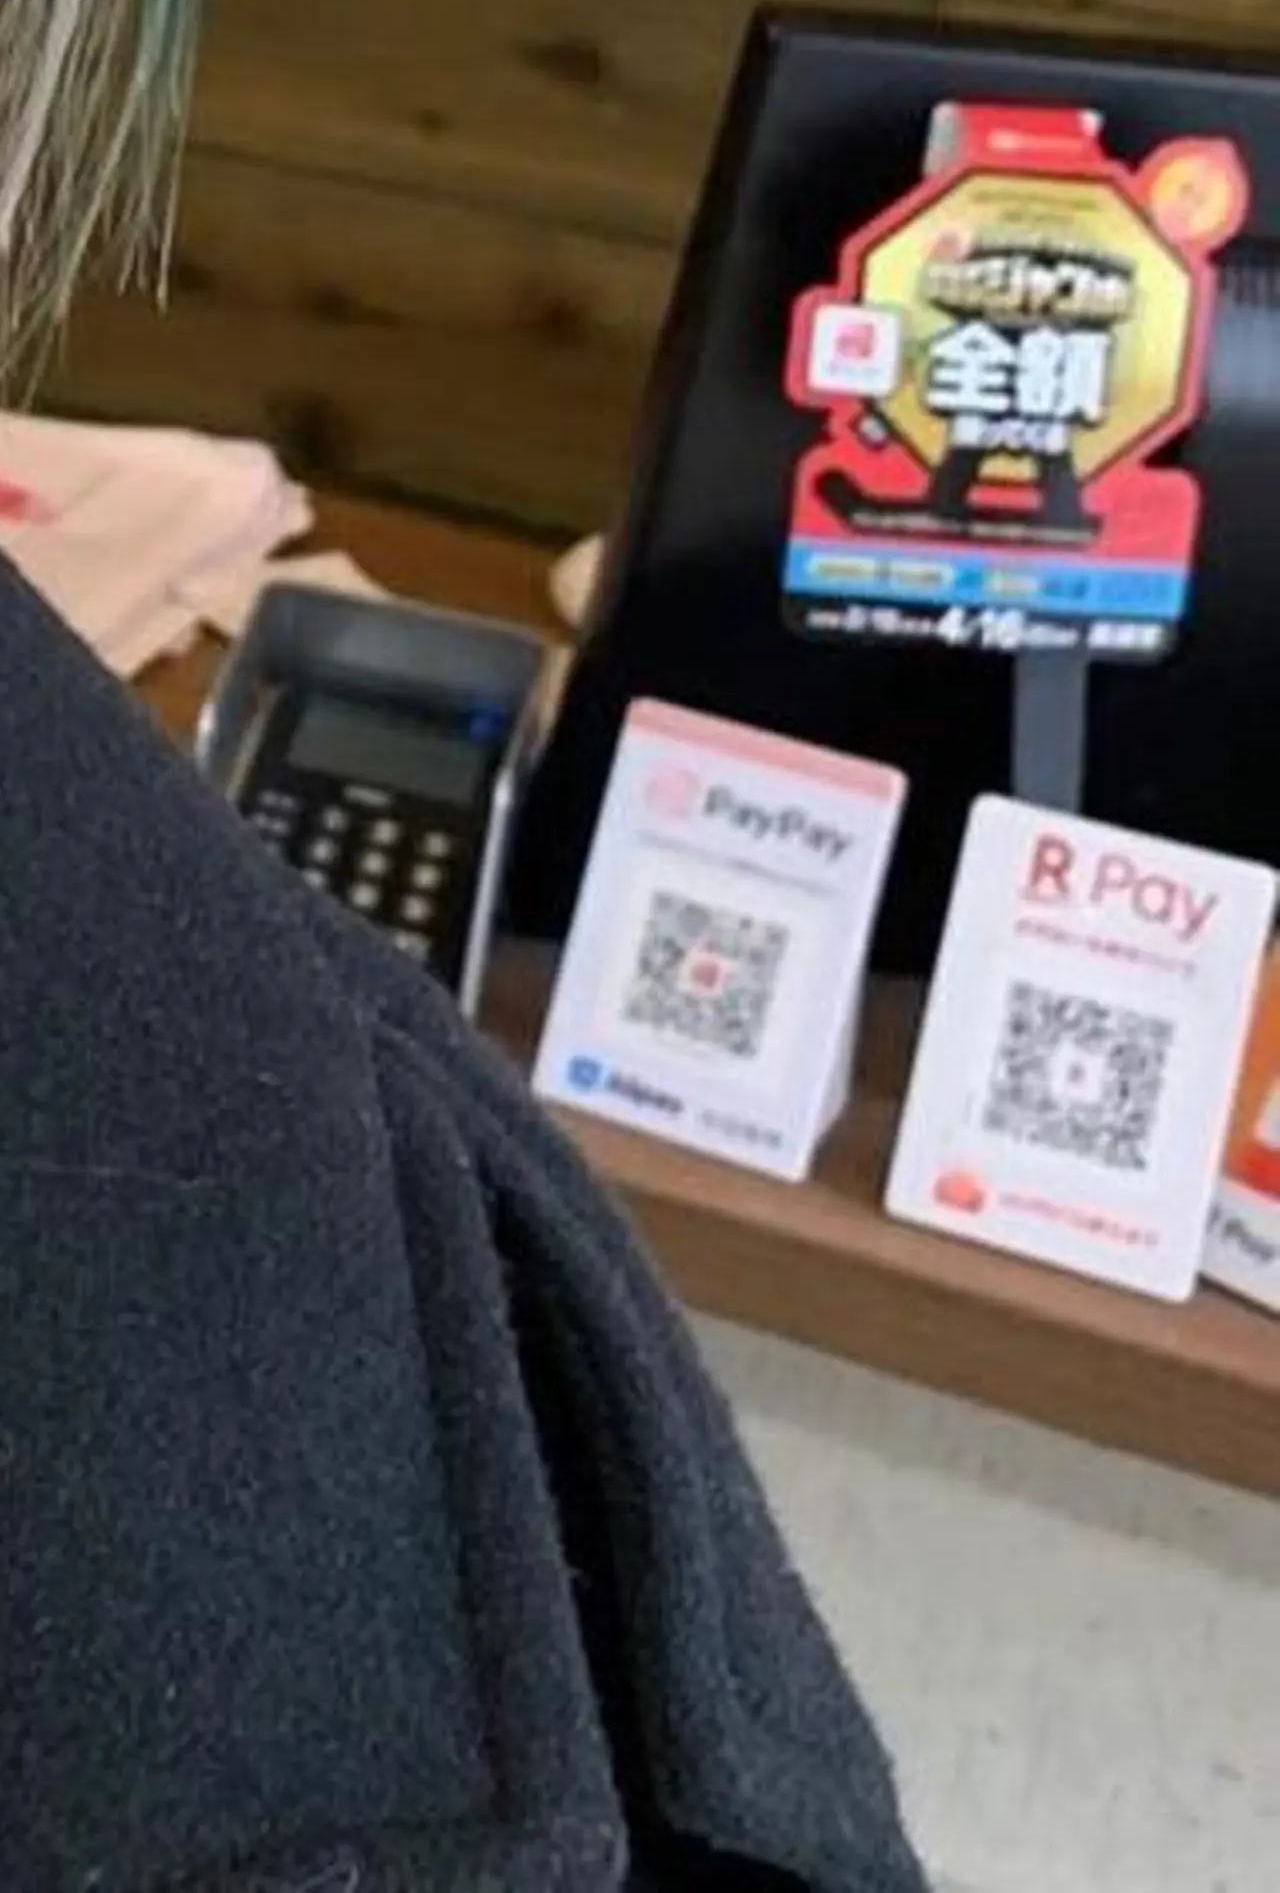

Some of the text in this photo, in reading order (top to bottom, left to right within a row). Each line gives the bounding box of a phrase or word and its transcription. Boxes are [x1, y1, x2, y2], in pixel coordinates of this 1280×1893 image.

[926, 320, 1110, 423] 全額
[703, 784, 857, 864] PayPay
[1089, 853, 1219, 943] Pay
